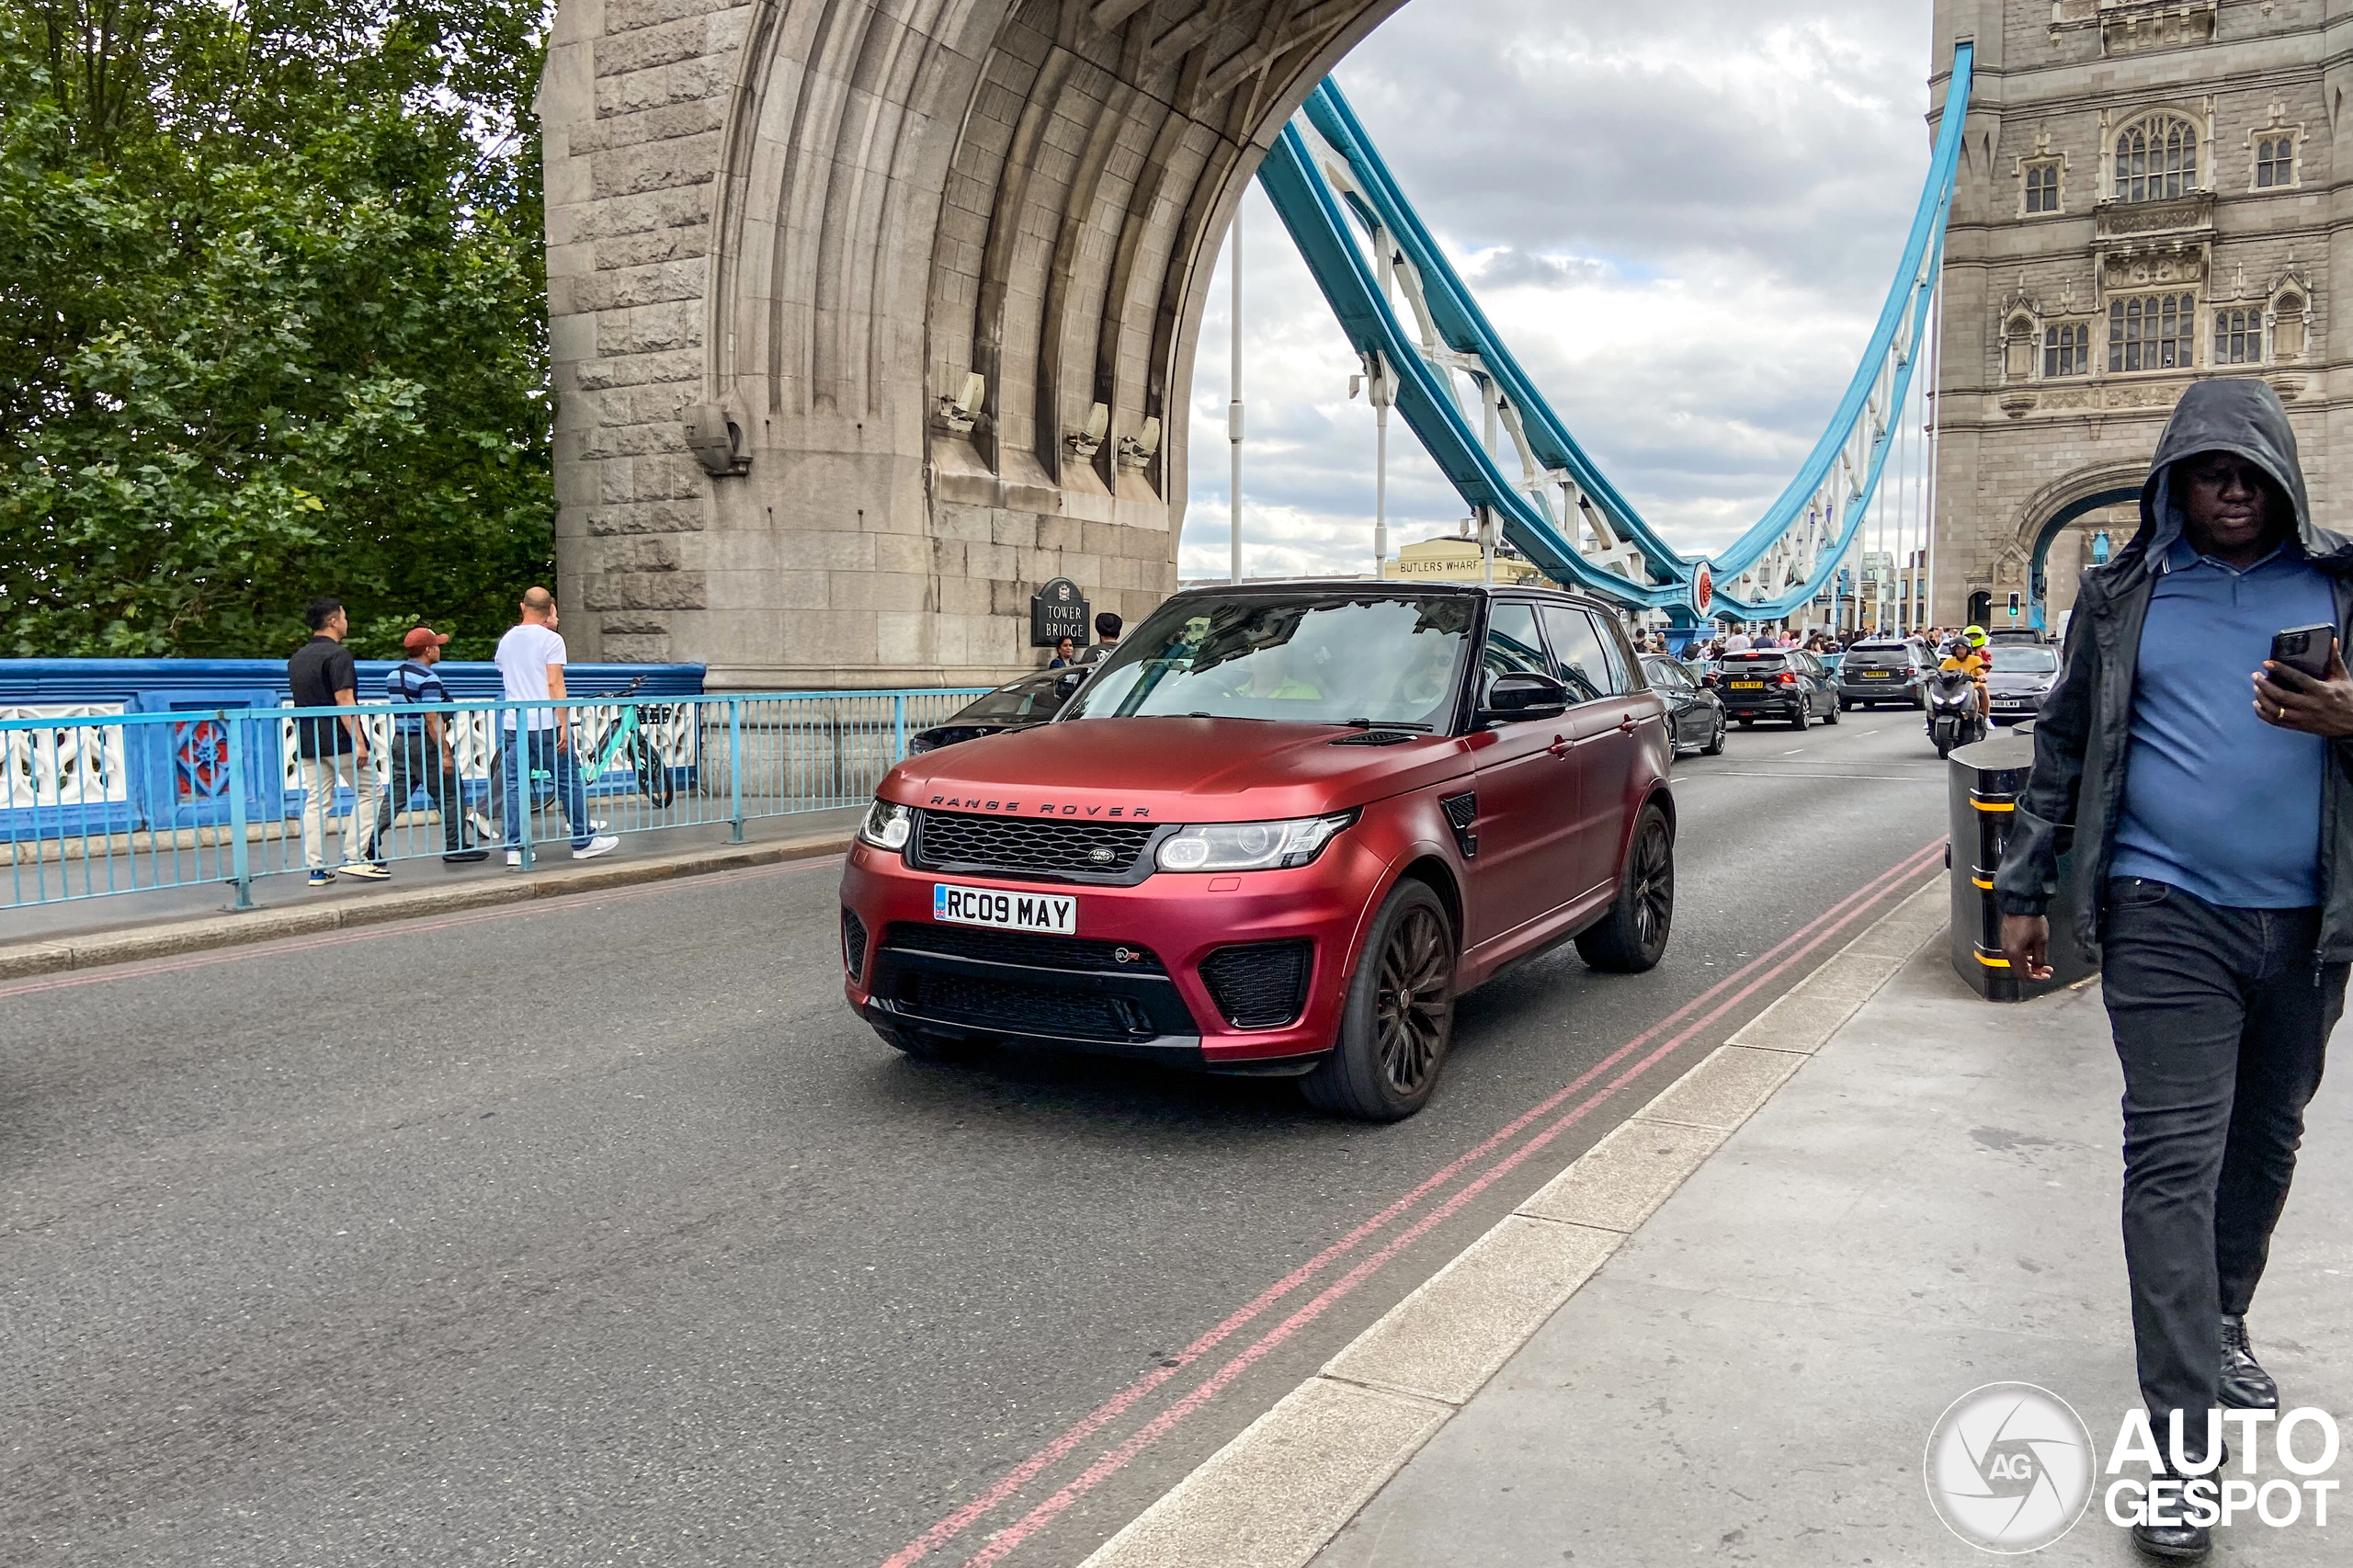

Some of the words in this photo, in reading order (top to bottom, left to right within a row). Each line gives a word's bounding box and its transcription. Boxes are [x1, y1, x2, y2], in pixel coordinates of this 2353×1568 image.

[1400, 562, 1443, 573] BUTLERS
[1446, 560, 1479, 571] WHARF
[1047, 605, 1082, 619] TOWER
[1046, 623, 1083, 637] BRIDGE
[930, 795, 1020, 812] RANGE
[1040, 803, 1150, 817] ROVER
[948, 890, 1009, 923] RC09
[1017, 897, 1070, 928] MAY
